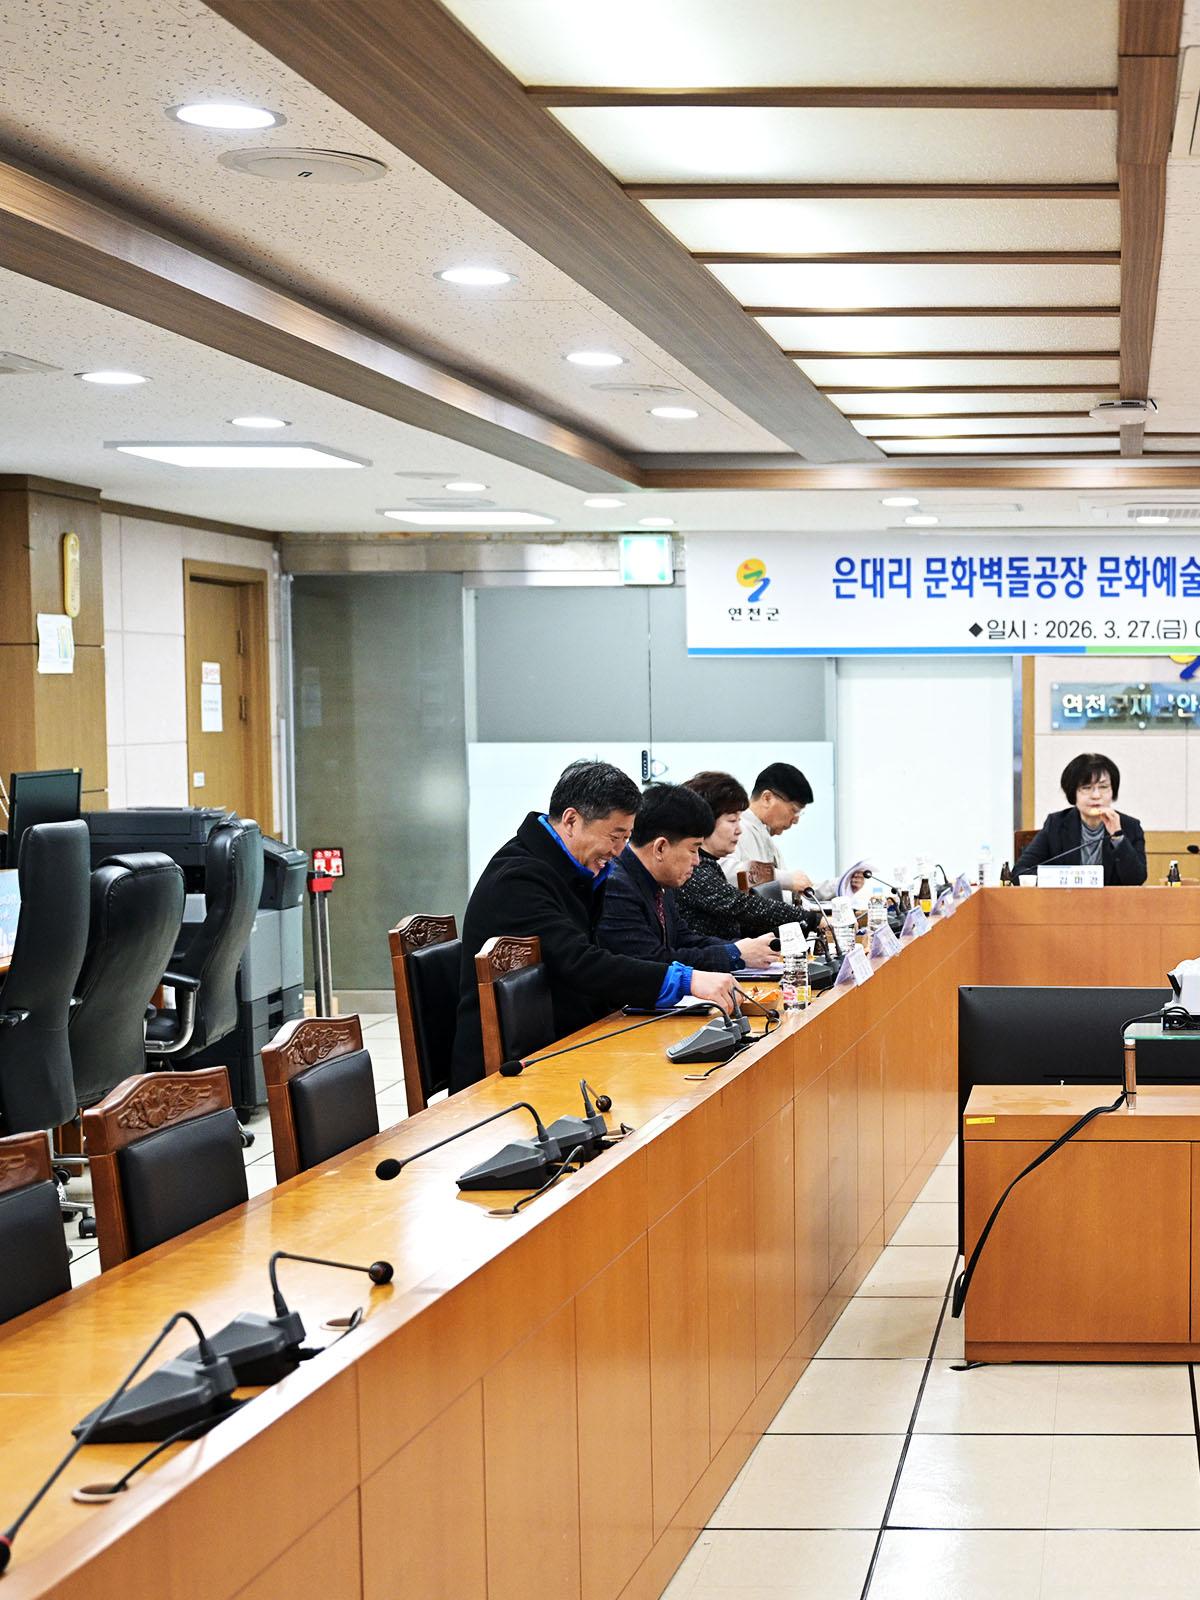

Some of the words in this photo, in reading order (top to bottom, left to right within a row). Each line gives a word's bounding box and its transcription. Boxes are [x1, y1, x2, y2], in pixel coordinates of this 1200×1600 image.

[832, 556, 912, 600] 은대리
[923, 555, 1088, 600] 문화벽돌공장
[728, 607, 780, 622] 연천군
[987, 619, 1027, 640] 일시
[1045, 620, 1097, 640] 2026.
[1103, 620, 1121, 640] 3.
